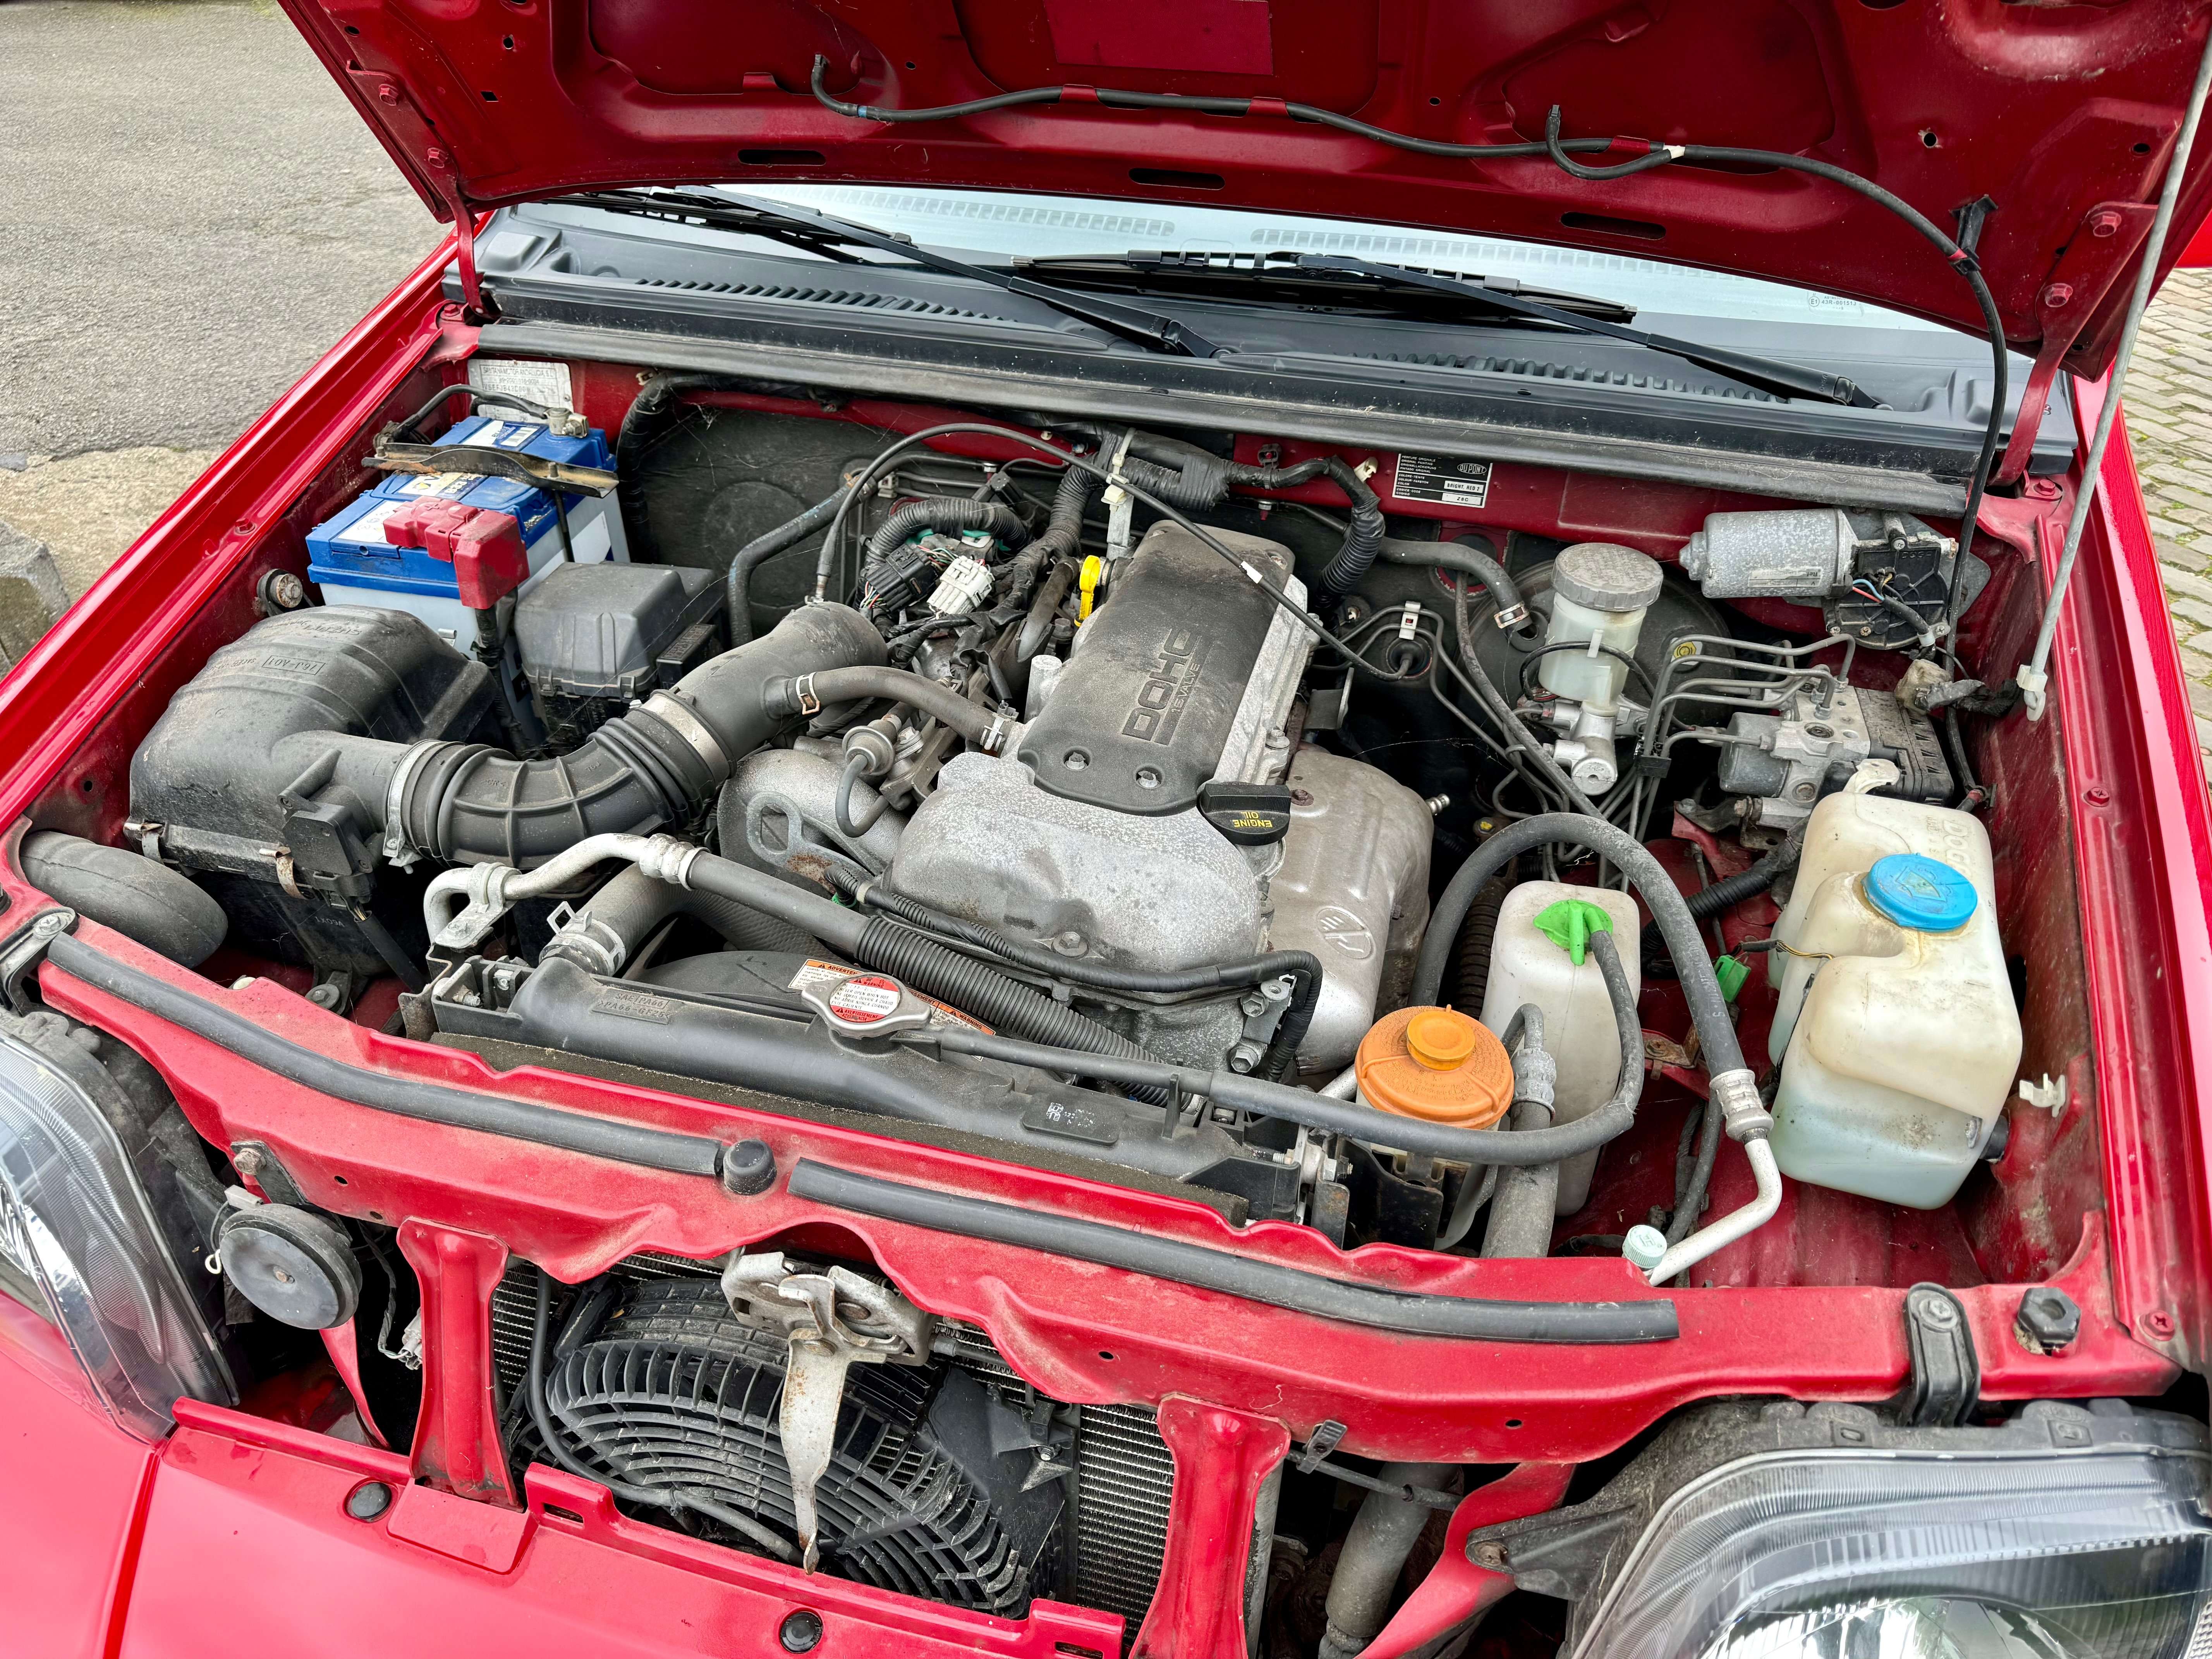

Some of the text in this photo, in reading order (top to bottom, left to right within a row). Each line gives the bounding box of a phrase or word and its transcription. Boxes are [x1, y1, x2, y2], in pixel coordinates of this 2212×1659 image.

[268, 657, 318, 672] 76J-A01
[1121, 628, 1199, 741] DOHC
[1232, 819, 1273, 828] ENGINE
[828, 965, 859, 975] ADVERTEN
[615, 993, 663, 1007] SAE PA66
[910, 991, 936, 1005] SSEMENT
[844, 1009, 878, 1019] AVERTISSEMENT
[959, 1013, 982, 1029] WARNING
